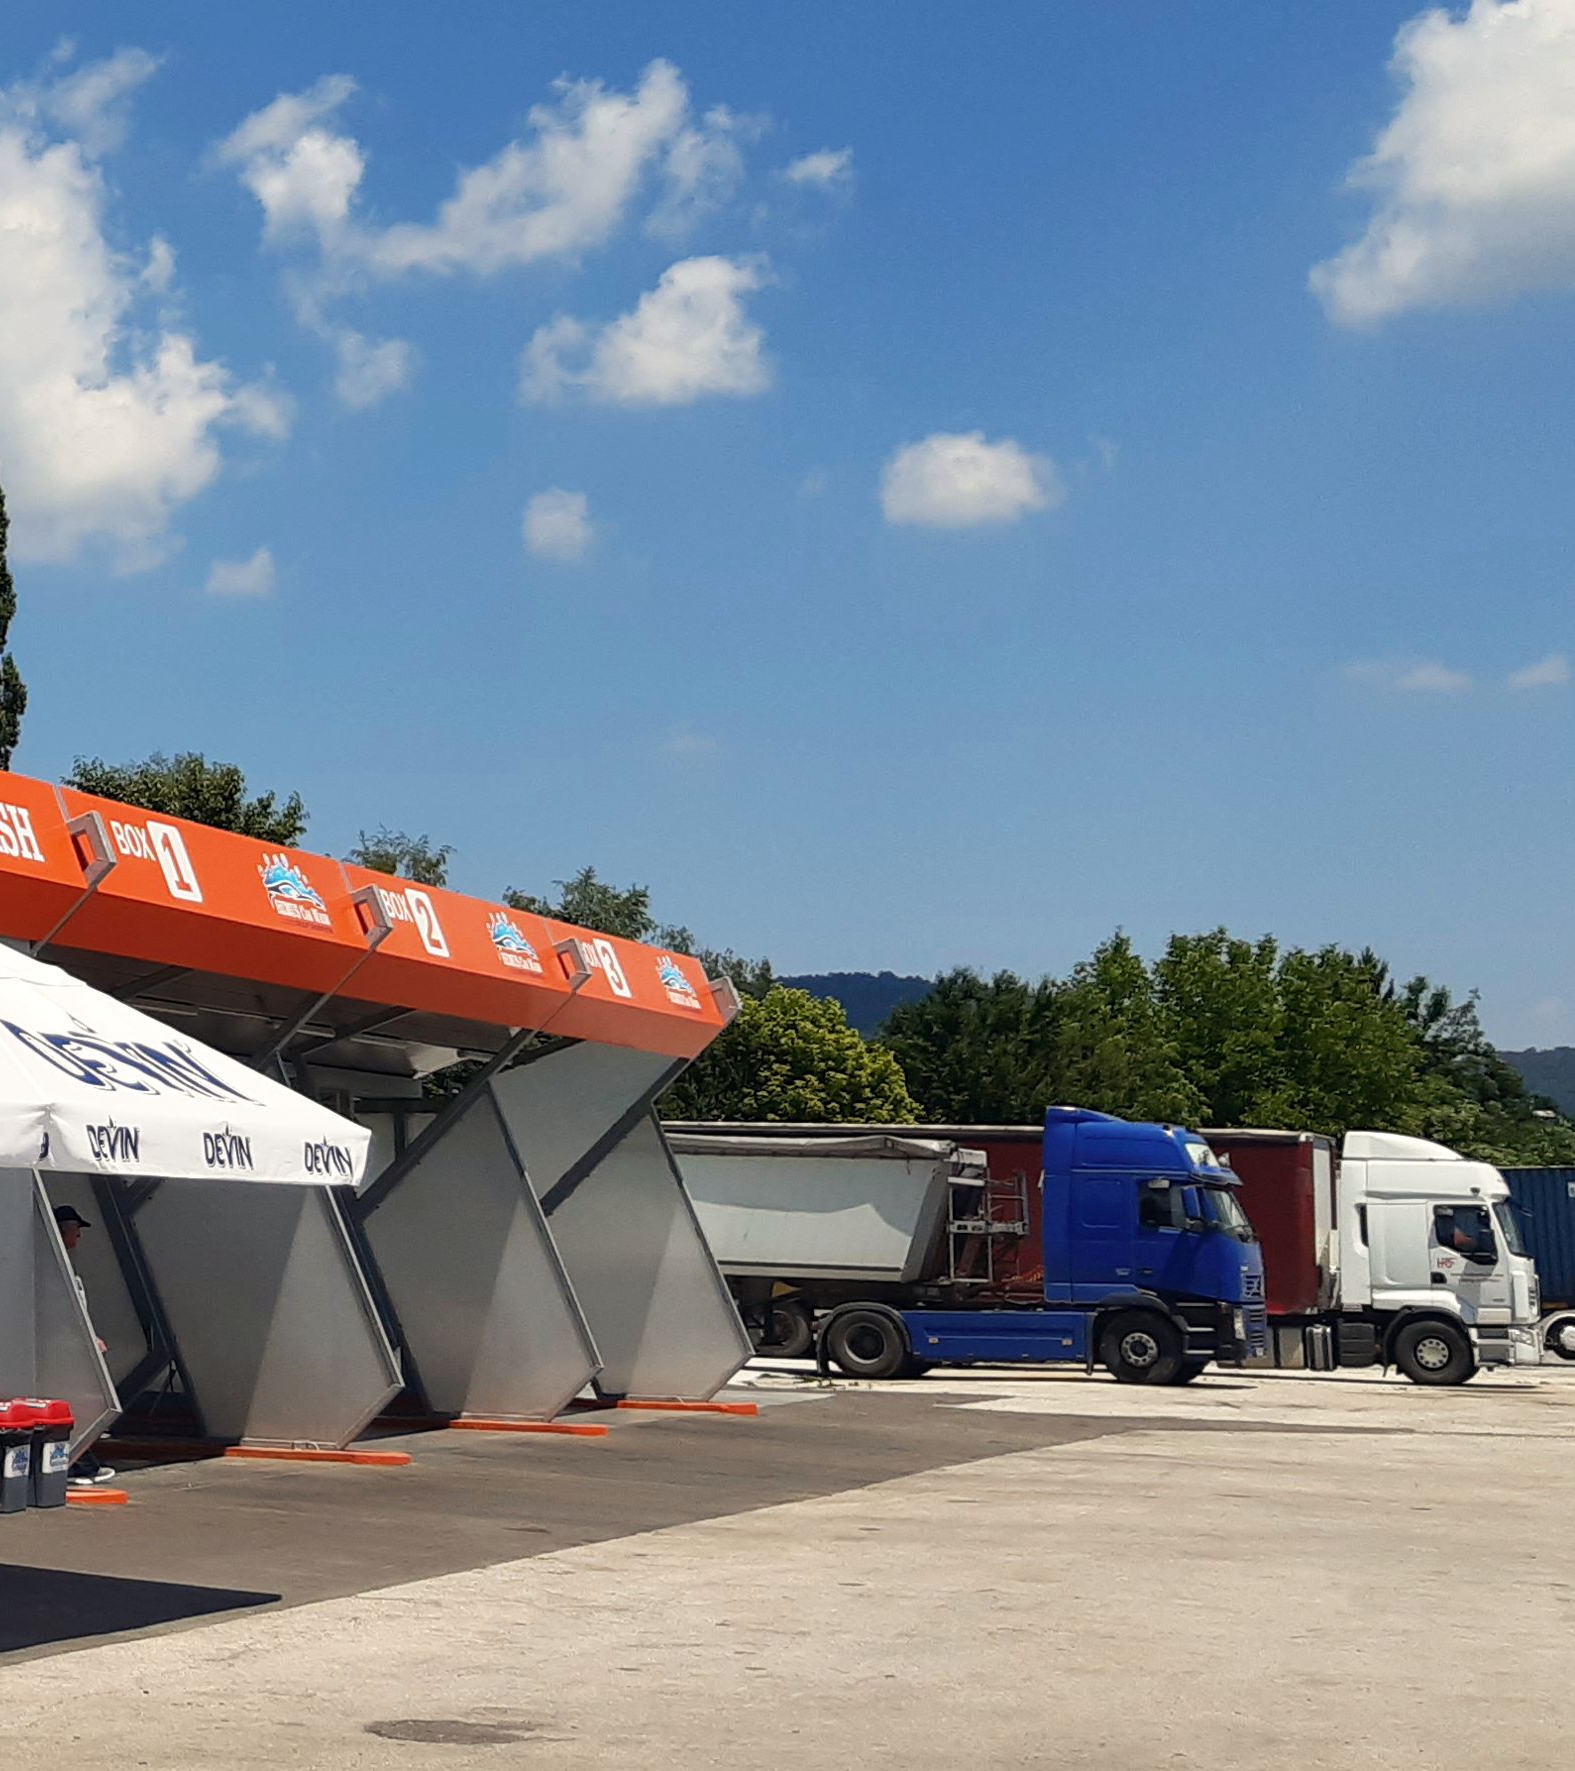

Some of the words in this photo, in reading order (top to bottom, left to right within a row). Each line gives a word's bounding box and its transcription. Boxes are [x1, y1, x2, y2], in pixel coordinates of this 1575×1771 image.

[110, 820, 157, 862] BOX
[379, 888, 414, 923] BOX
[86, 1124, 140, 1160] DEVIN
[202, 1131, 254, 1169] DEVIN
[303, 1141, 354, 1180] DEVIN
